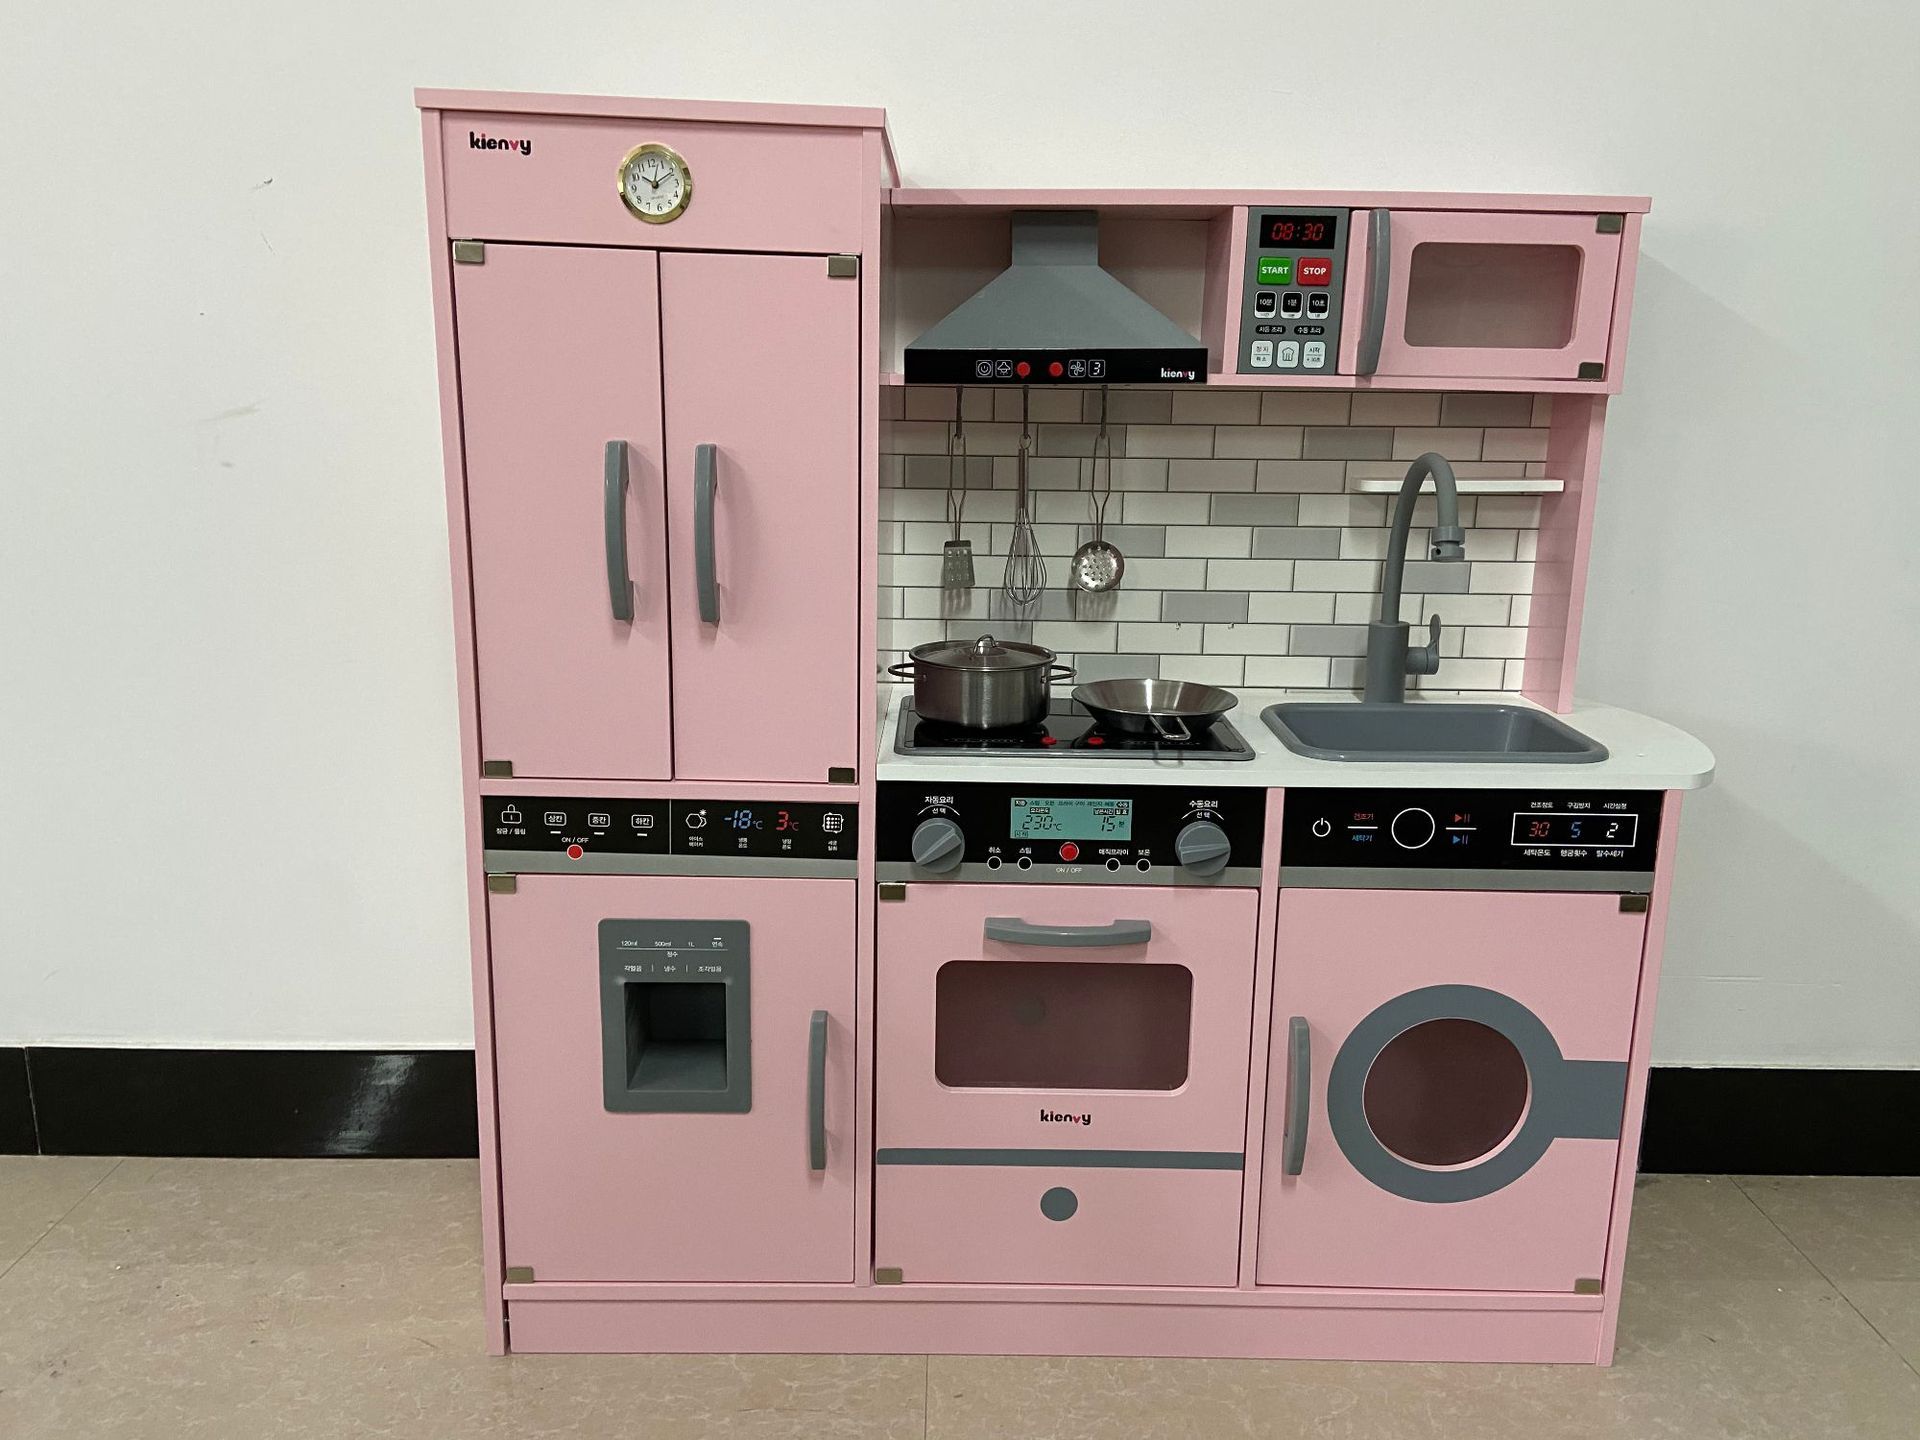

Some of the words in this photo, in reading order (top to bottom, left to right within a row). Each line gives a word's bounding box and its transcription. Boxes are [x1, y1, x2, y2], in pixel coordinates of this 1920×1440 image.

[469, 131, 531, 155] kienvy
[647, 159, 656, 168] 12
[638, 164, 645, 172] 11
[669, 168, 675, 177] 2
[632, 173, 639, 181] 10
[674, 179, 679, 188] 3
[631, 184, 637, 193] 9
[674, 190, 679, 198] 4
[636, 196, 642, 204] 8
[668, 199, 673, 207] 5
[646, 202, 651, 211] 7
[657, 203, 663, 211] 6
[1272, 223, 1324, 241] 08:30
[1262, 266, 1289, 274] START
[1303, 267, 1327, 275] STOP
[1093, 362, 1101, 375] 3
[1161, 368, 1195, 380] kienvy
[924, 796, 954, 804] 자동요리
[1189, 800, 1218, 808] 수동요리
[1354, 813, 1374, 821] 건조기
[1529, 821, 1550, 837] 30
[1571, 822, 1582, 838] 5
[1606, 822, 1619, 838] 2
[1352, 834, 1373, 842] 세탁기
[1523, 849, 1551, 857] 세탁온도
[1040, 1109, 1091, 1126] kienvy
